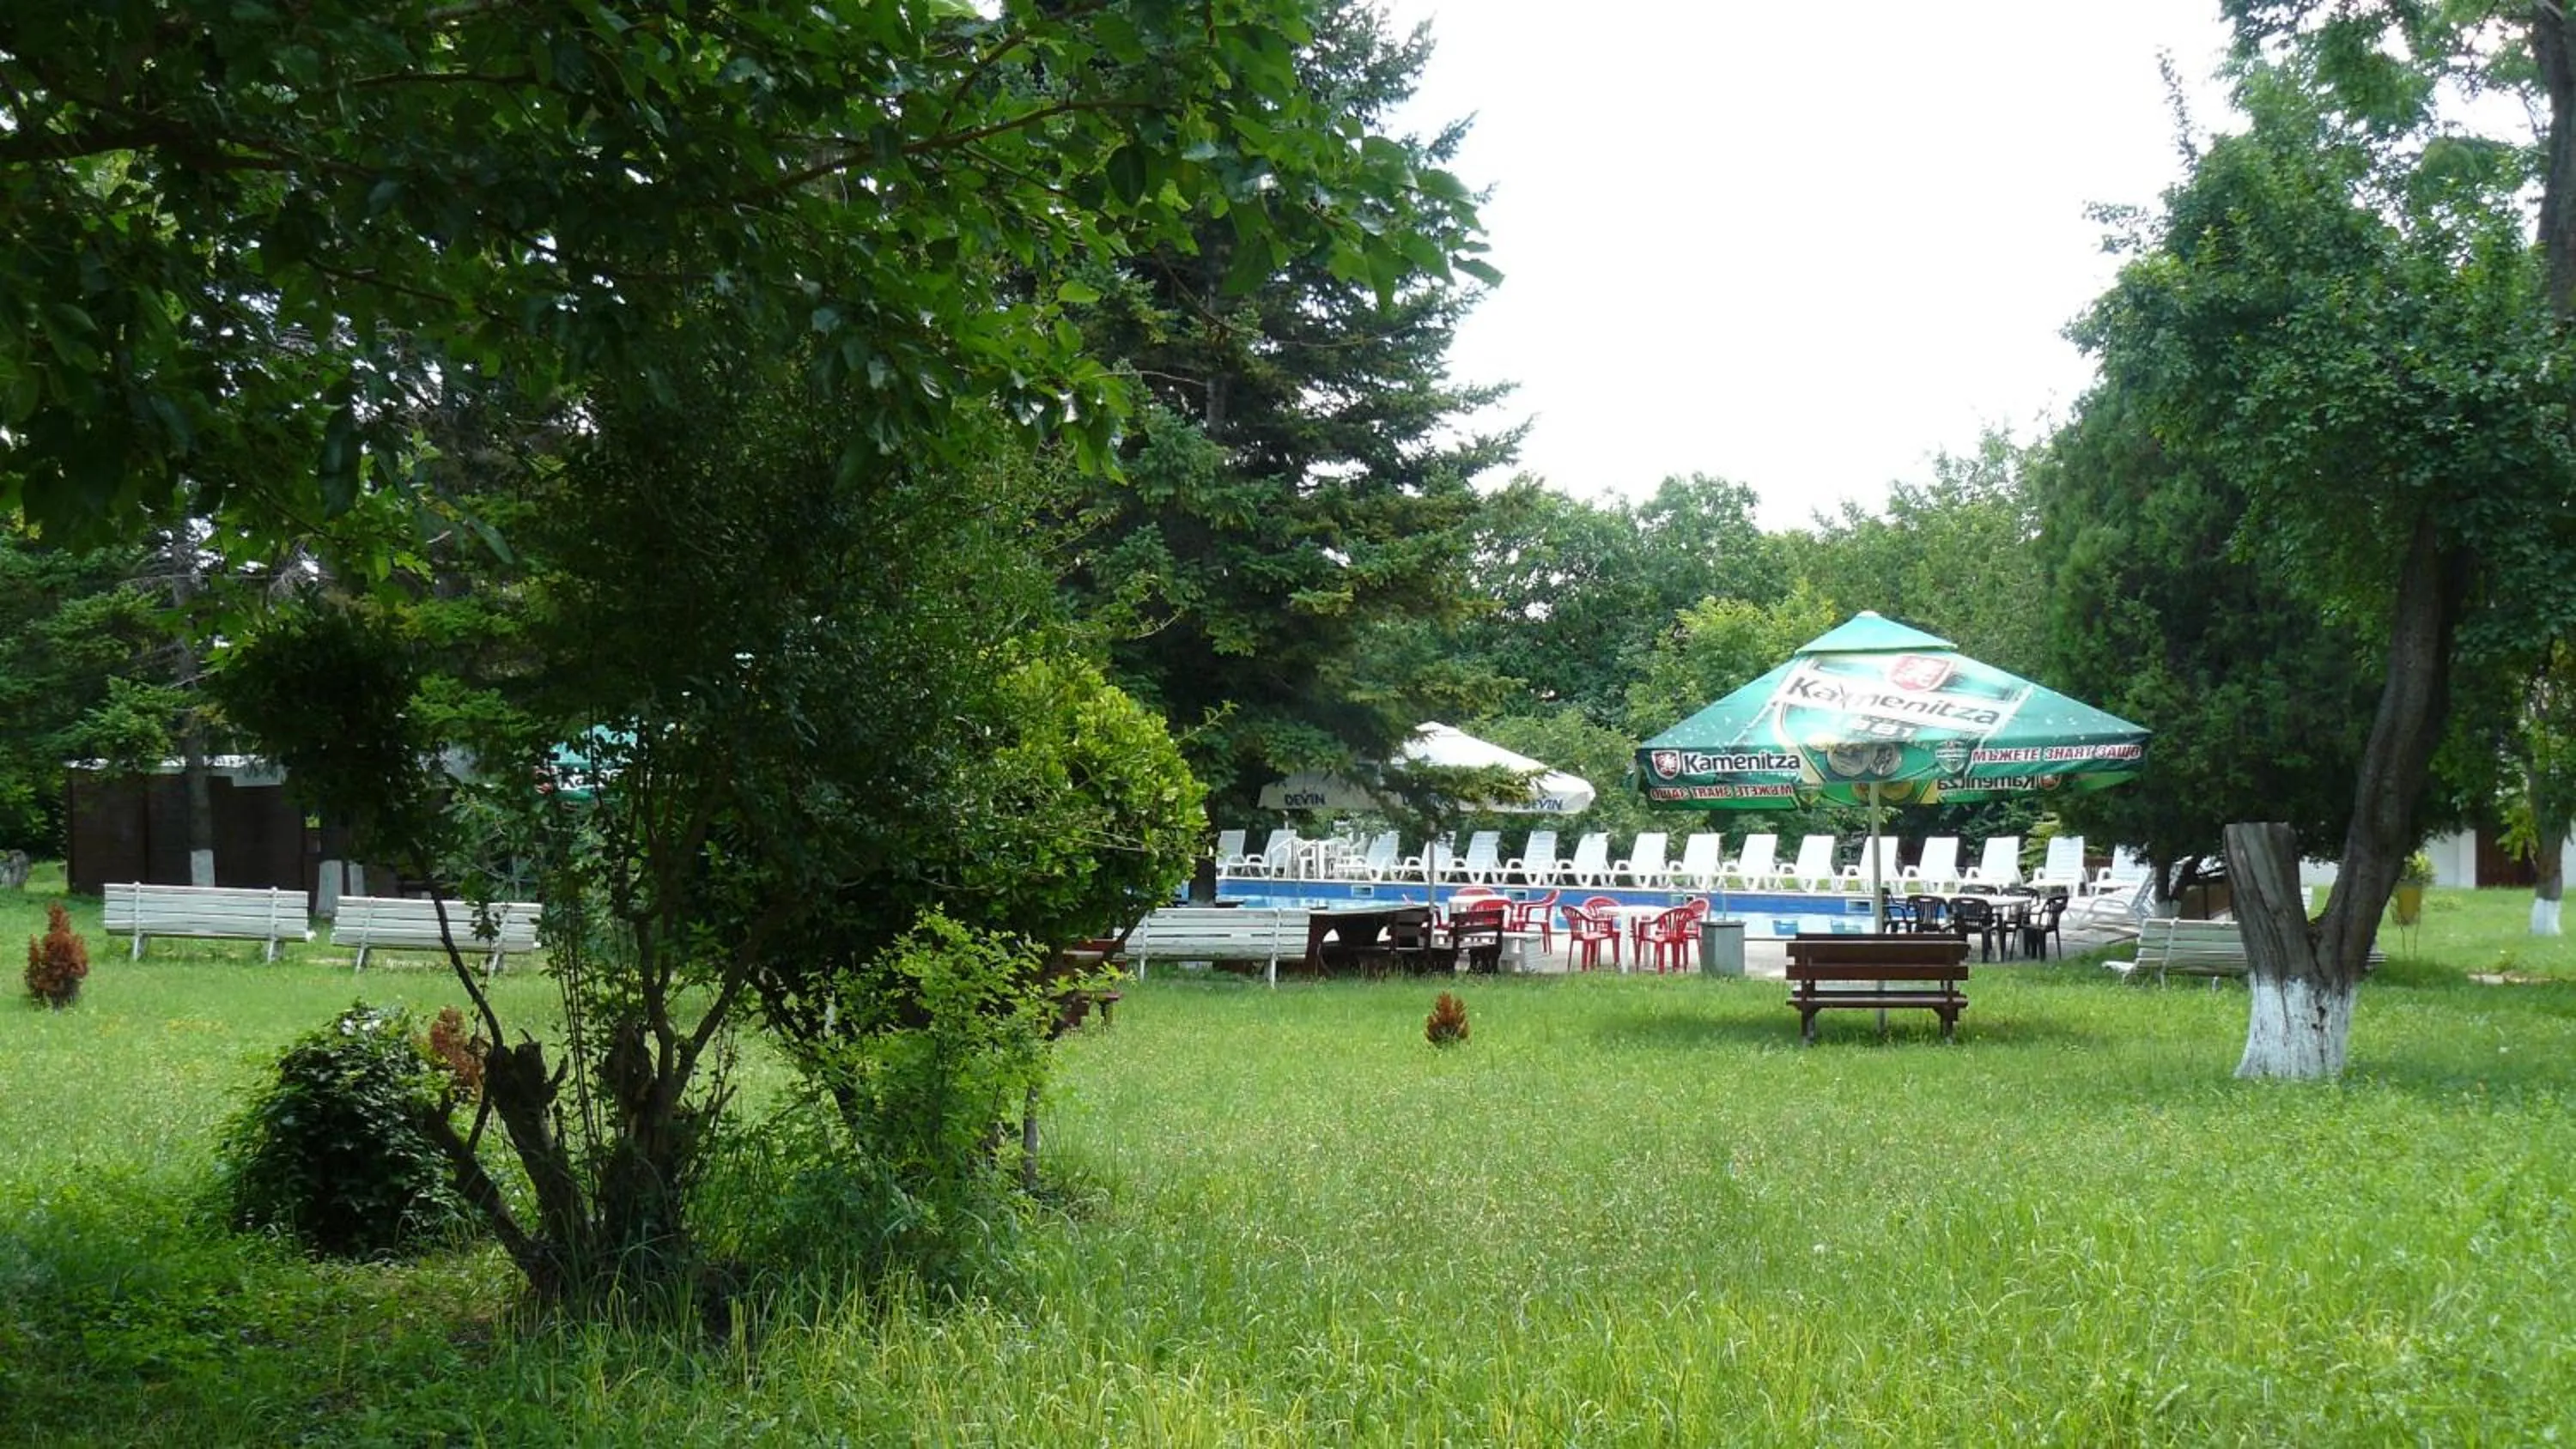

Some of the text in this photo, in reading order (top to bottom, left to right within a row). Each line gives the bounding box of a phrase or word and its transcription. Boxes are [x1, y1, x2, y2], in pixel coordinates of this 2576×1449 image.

[1787, 676, 2001, 726] Kamenitza
[1684, 751, 1801, 773] Kamenitza
[1972, 748, 2040, 762] МЪЖЕТЕ
[1284, 792, 1327, 806] DEVIN
